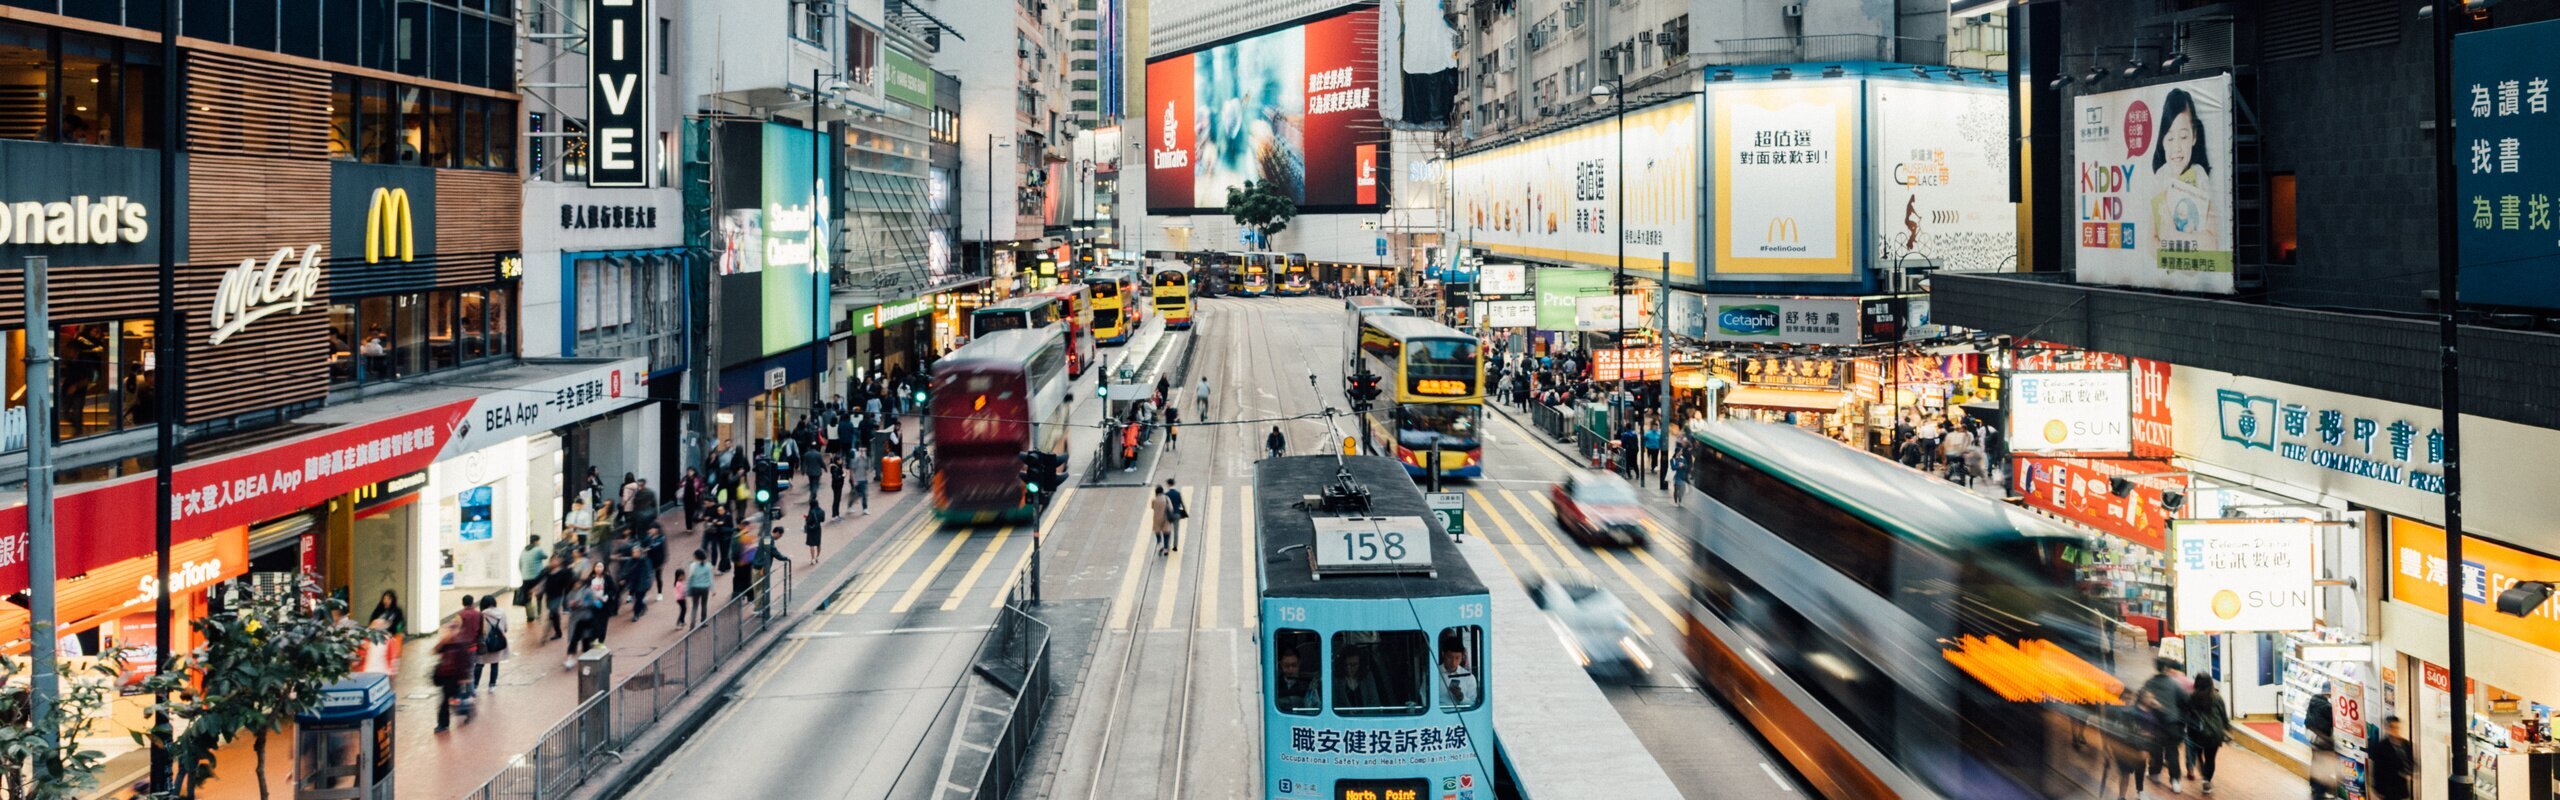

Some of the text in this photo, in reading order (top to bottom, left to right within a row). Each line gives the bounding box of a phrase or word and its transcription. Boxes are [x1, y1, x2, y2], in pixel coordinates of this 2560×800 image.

[599, 0, 637, 170] IVE
[2470, 77, 2549, 118] 為讀者
[1754, 130, 1811, 147] 超值選
[1153, 147, 1188, 169] Emirates
[2471, 137, 2520, 174] 找書
[1577, 158, 1604, 201] 超值選
[2082, 194, 2123, 220] LAND
[2472, 193, 2560, 231] 為書找
[2083, 226, 2134, 246] 兒童天地
[1723, 313, 1776, 330] Cetaphil
[1785, 311, 1840, 326] 舒特膚
[486, 403, 512, 432] BEA
[516, 402, 538, 426] App
[2073, 421, 2121, 435] SUN
[2281, 442, 2446, 495] THE COMMERCIAL PRES
[271, 468, 302, 498] App
[1343, 532, 1406, 562] 158
[1458, 603, 1484, 619] 158
[2248, 590, 2307, 608] SUN
[1279, 606, 1306, 622] 158
[2426, 669, 2448, 688] $400
[2339, 695, 2360, 721] 98
[1292, 725, 1468, 755] 職安健投訴熱線
[1281, 751, 1478, 767] Occupational Safety and Health Complaint Hotline
[1346, 788, 1416, 800] North Point
